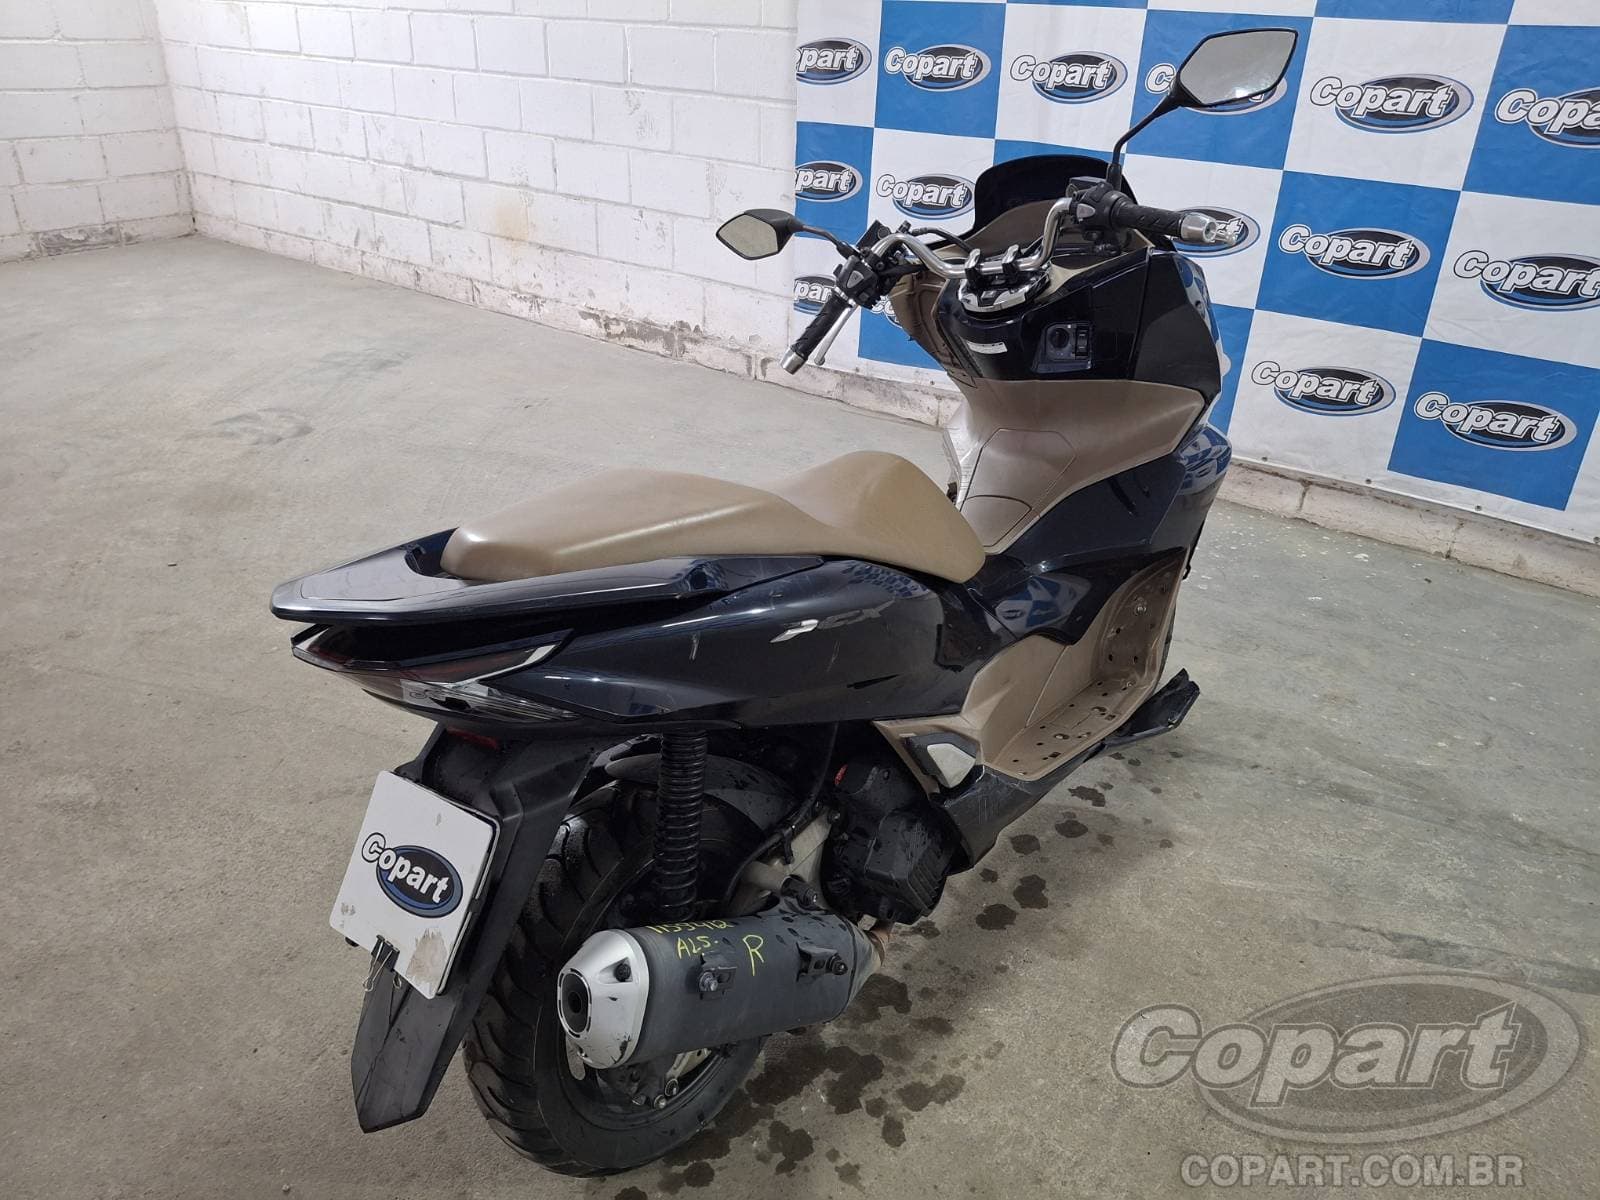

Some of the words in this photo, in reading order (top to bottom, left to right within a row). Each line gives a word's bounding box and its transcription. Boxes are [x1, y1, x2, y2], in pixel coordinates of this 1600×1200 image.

[795, 45, 859, 73] part
[885, 46, 978, 80] Copart
[1010, 54, 1112, 90] Copart
[1310, 76, 1455, 118] Copart
[795, 168, 852, 193] part
[876, 173, 967, 207] Copart
[1278, 223, 1416, 269] Copart
[1453, 249, 1600, 299] Copart
[1251, 361, 1380, 404] Copart
[1414, 392, 1562, 443] Copart
[362, 832, 449, 903] Copart
[742, 934, 764, 976] R
